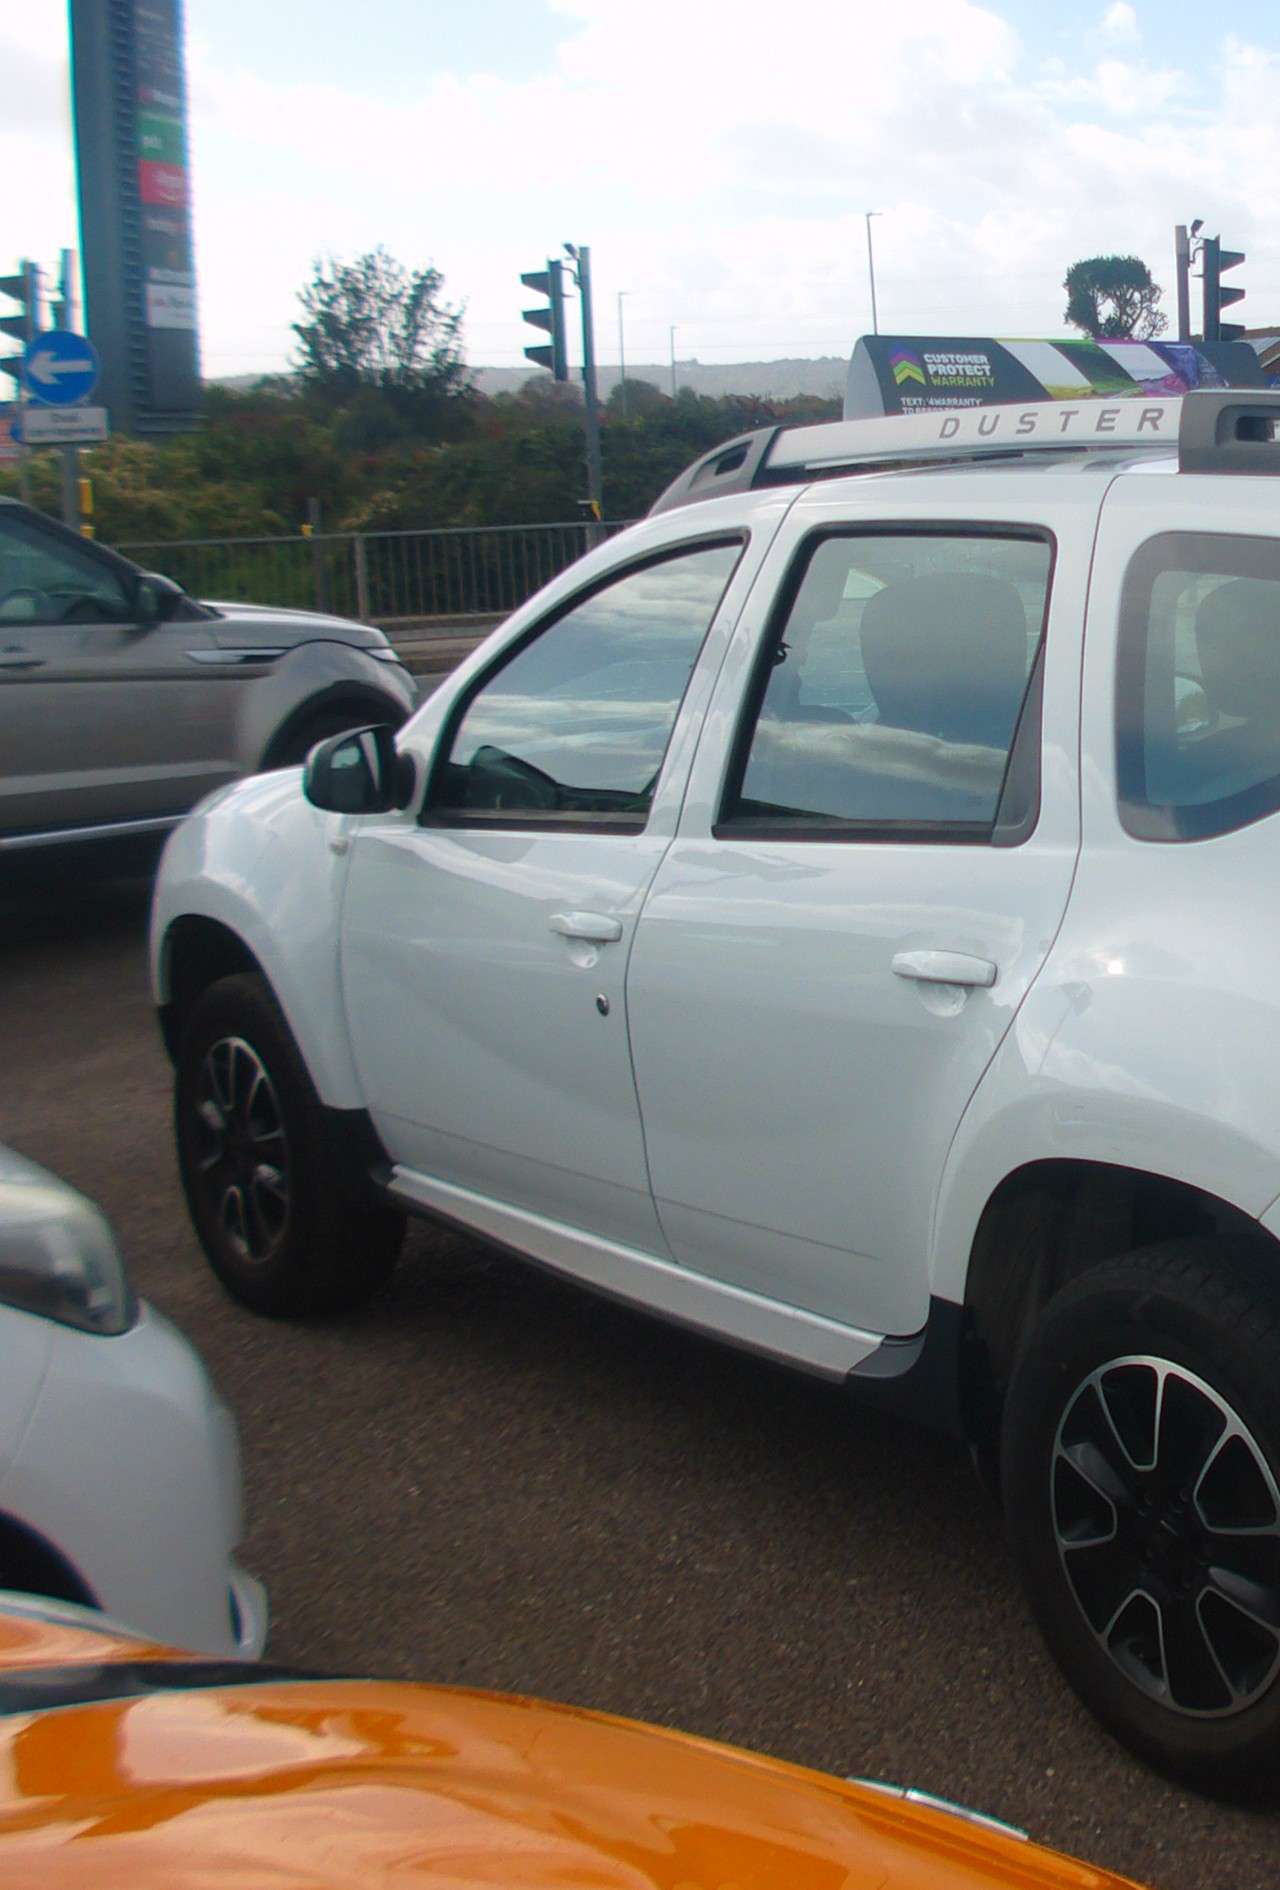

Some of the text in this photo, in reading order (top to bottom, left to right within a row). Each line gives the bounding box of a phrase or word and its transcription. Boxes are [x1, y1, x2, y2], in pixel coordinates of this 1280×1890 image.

[923, 353, 989, 364] CUSTOMER
[927, 364, 991, 376] PROTECT
[931, 376, 995, 387] WARRANTY
[939, 408, 1165, 439] DUSTER
